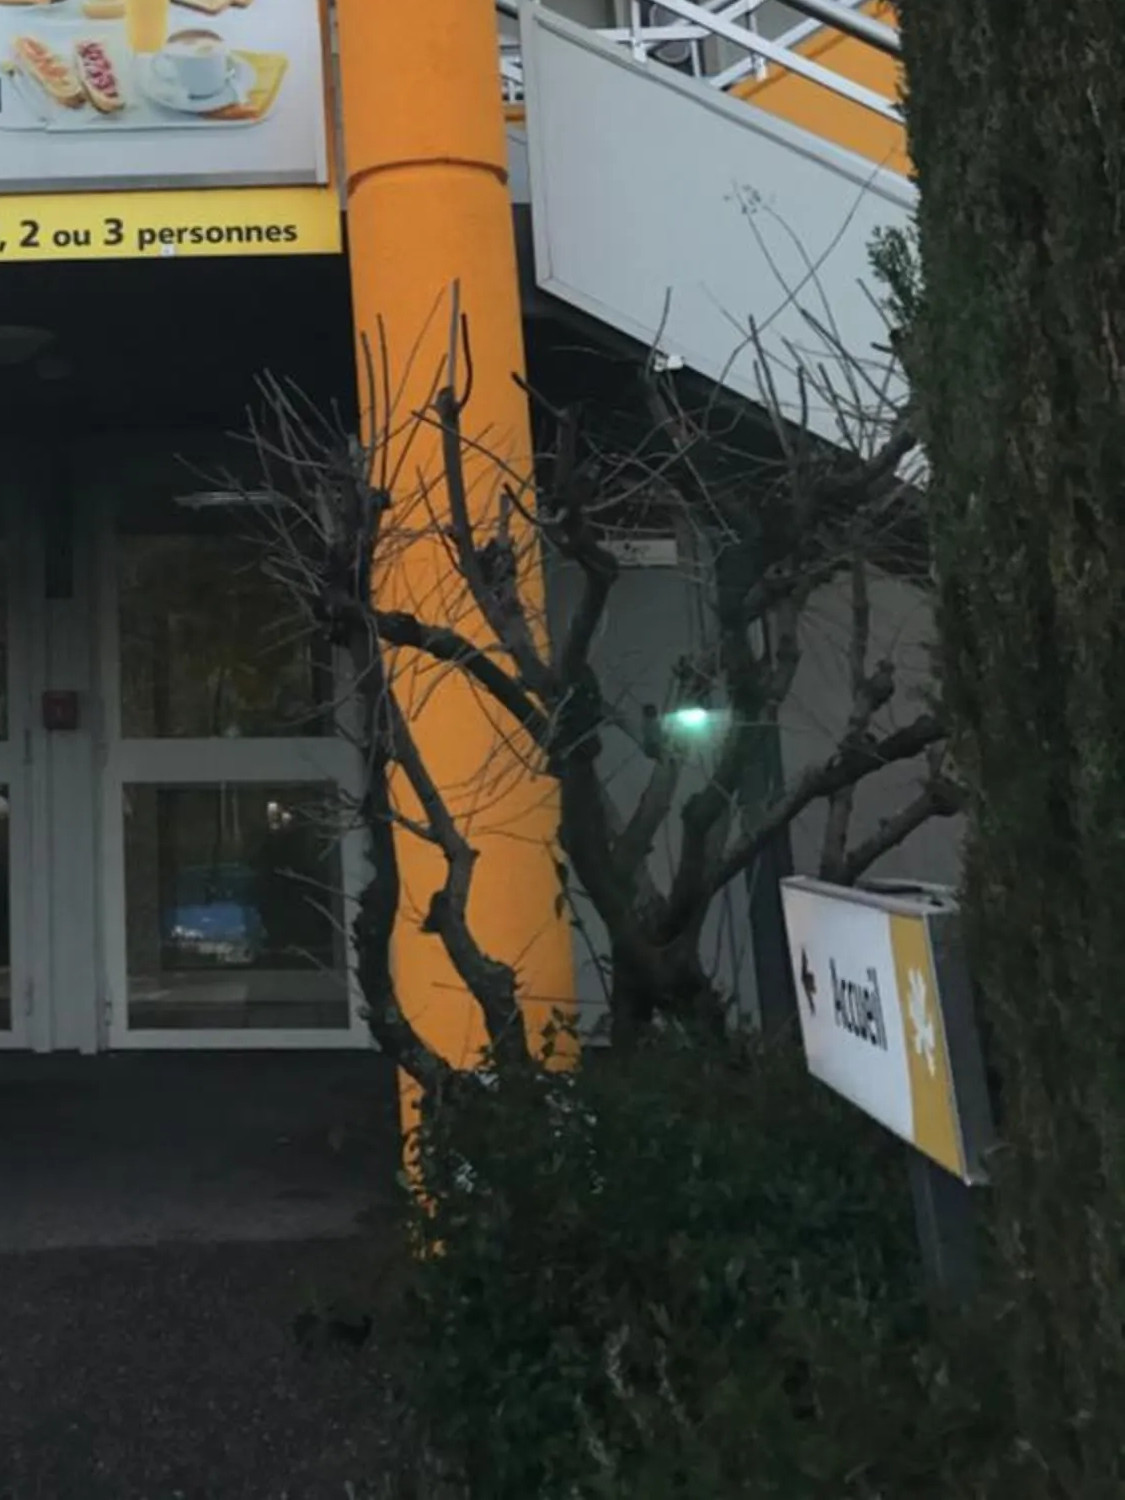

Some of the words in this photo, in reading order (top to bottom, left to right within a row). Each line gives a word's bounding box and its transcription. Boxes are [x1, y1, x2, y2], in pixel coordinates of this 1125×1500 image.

[19, 220, 41, 248] 2
[52, 229, 92, 247] ou
[103, 218, 124, 245] 3
[137, 224, 298, 251] personnes
